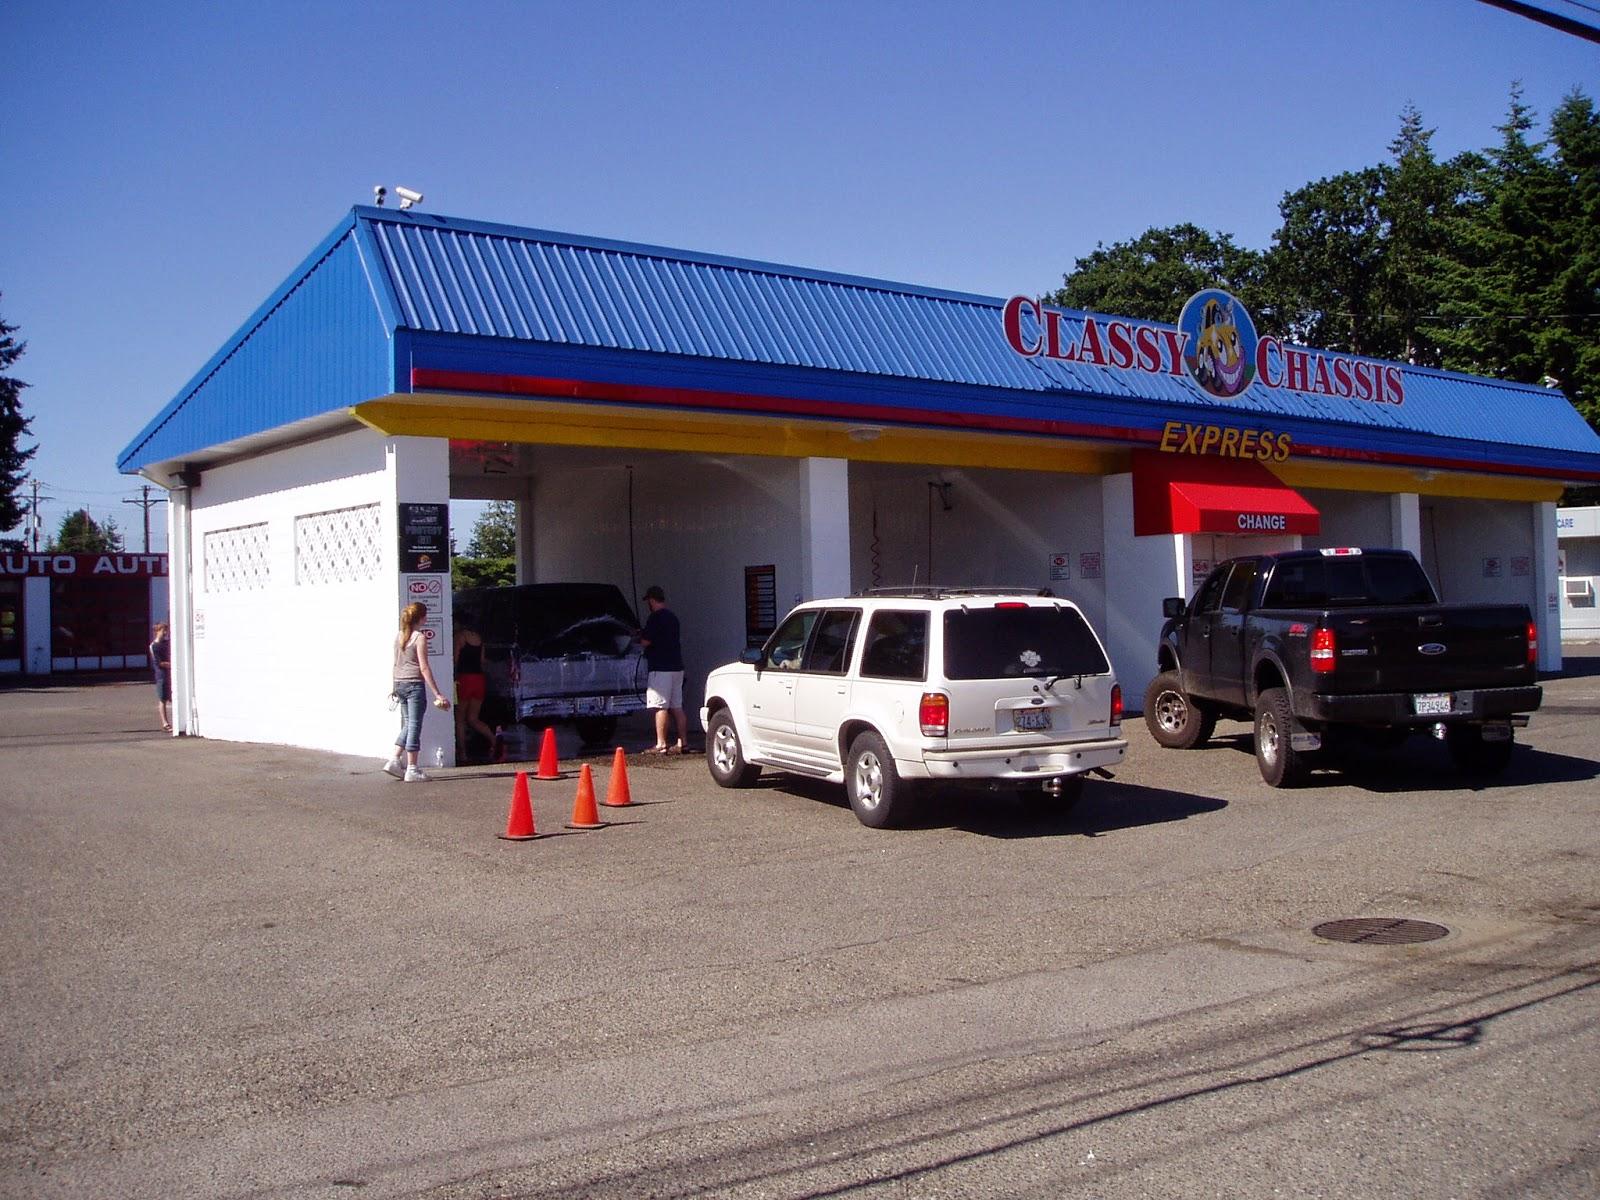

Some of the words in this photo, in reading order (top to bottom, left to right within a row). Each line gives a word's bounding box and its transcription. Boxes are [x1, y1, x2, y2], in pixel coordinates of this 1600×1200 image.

[1003, 295, 1190, 377] CLASSY
[1256, 335, 1405, 406] CHASSIS
[1159, 421, 1292, 463] EXPRESS
[1237, 513, 1286, 530] CHANGE
[411, 583, 427, 593] NO
